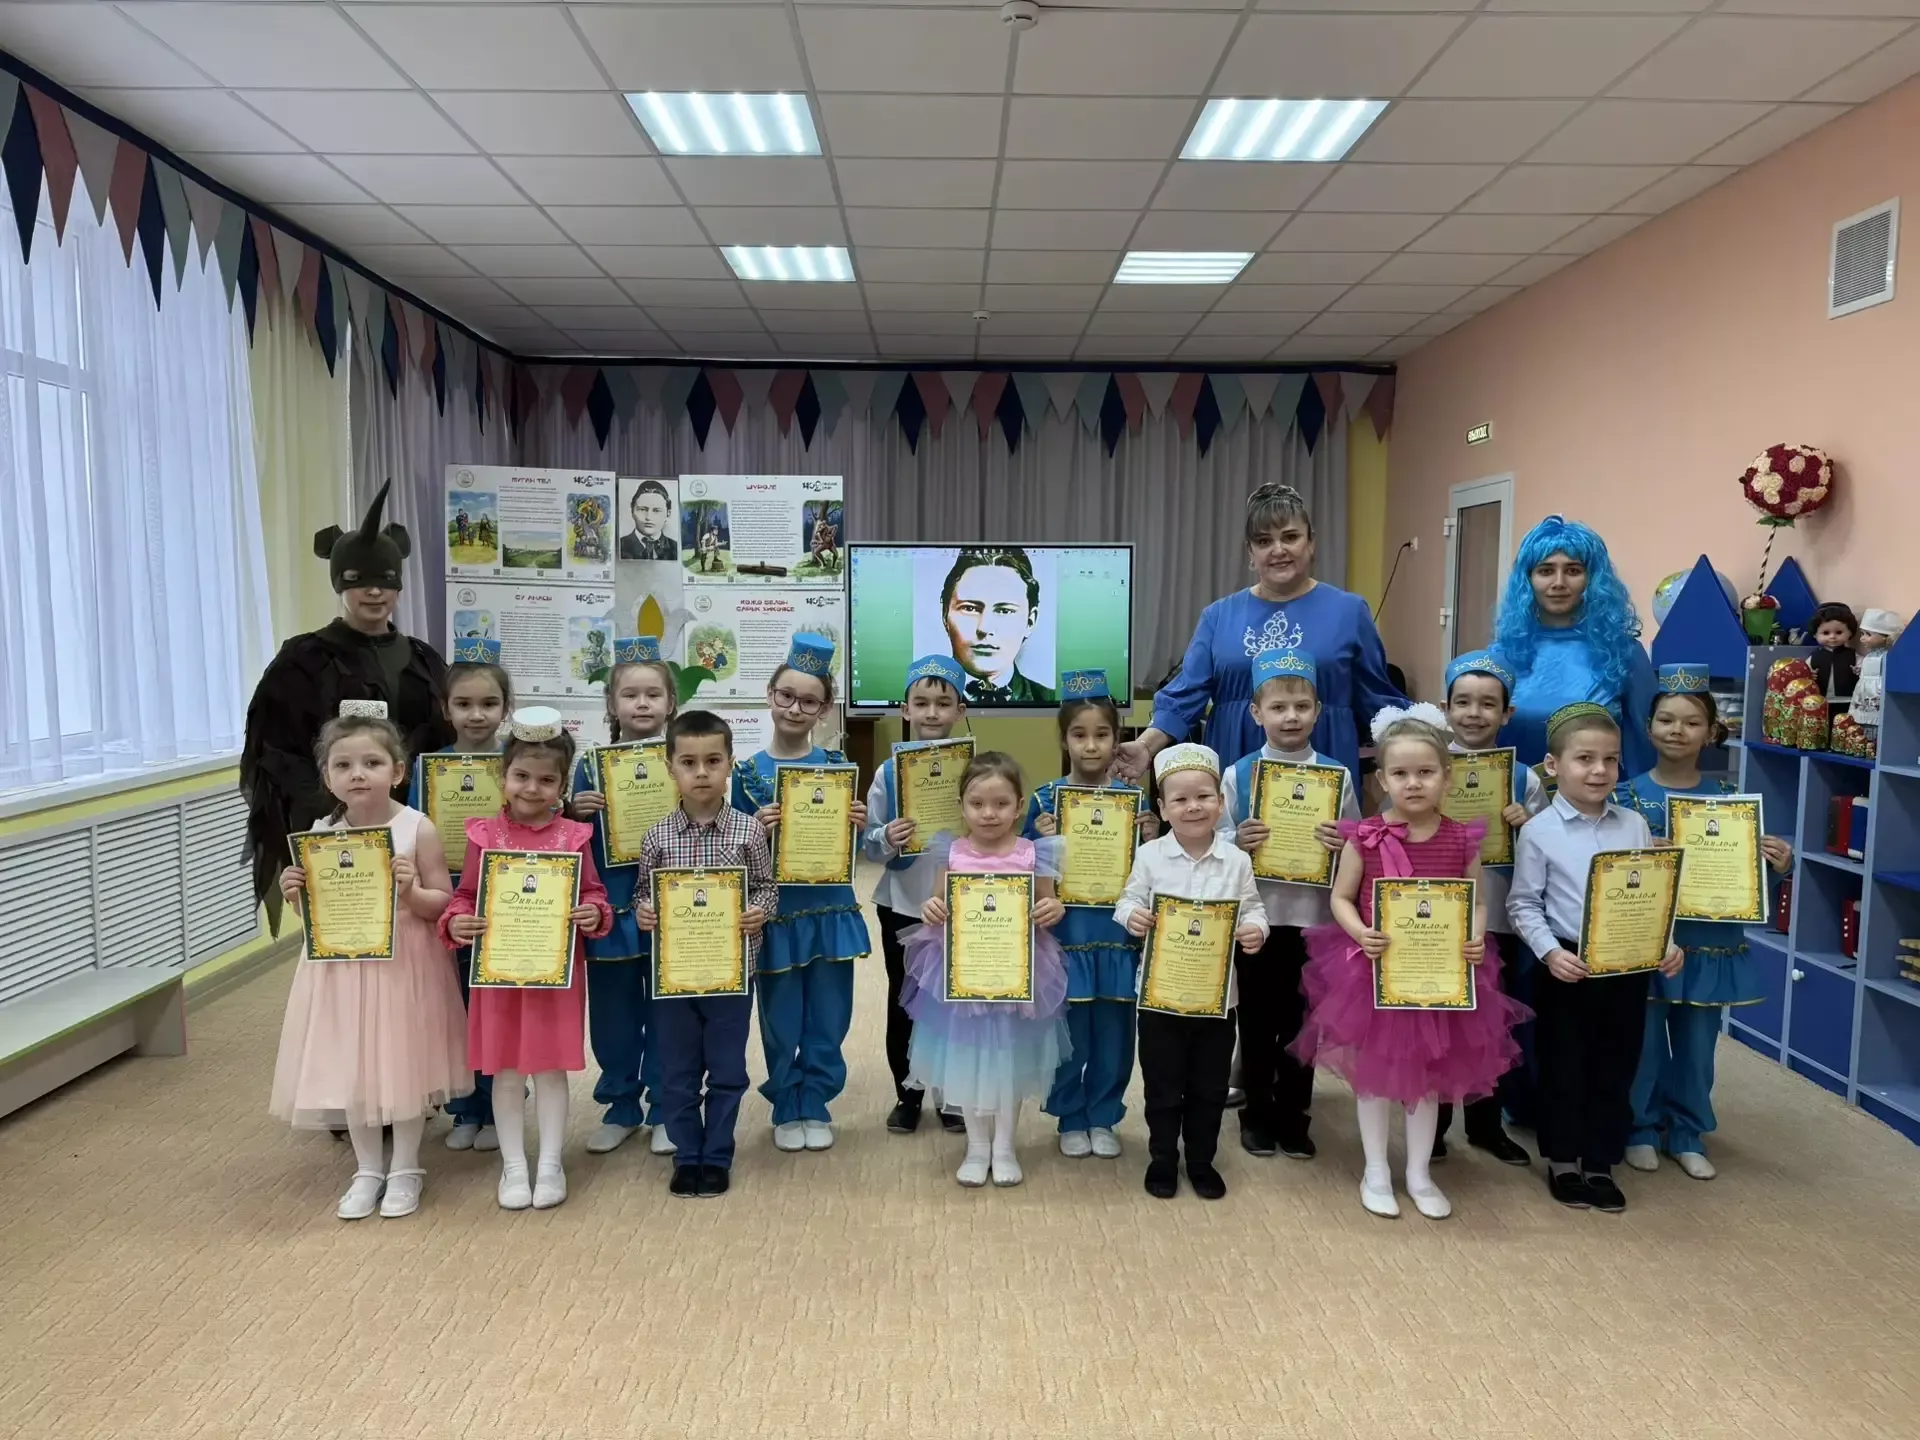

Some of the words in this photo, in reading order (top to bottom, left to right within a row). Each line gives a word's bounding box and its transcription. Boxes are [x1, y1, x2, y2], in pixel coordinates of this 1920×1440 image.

[617, 780, 665, 792] Диплом
[440, 790, 492, 802] Диплом
[793, 802, 838, 814] Диплом
[1272, 796, 1320, 812] Диплом
[1072, 823, 1118, 836] Диплом
[1686, 834, 1738, 848] Диплом
[318, 867, 374, 880] Диплом
[498, 891, 554, 905] Диплом
[1605, 888, 1656, 900] Диплом
[673, 906, 724, 919] Диплом
[964, 910, 1012, 923] Диплом
[1394, 917, 1450, 929] Диплом
[1166, 931, 1215, 946] Диплом
